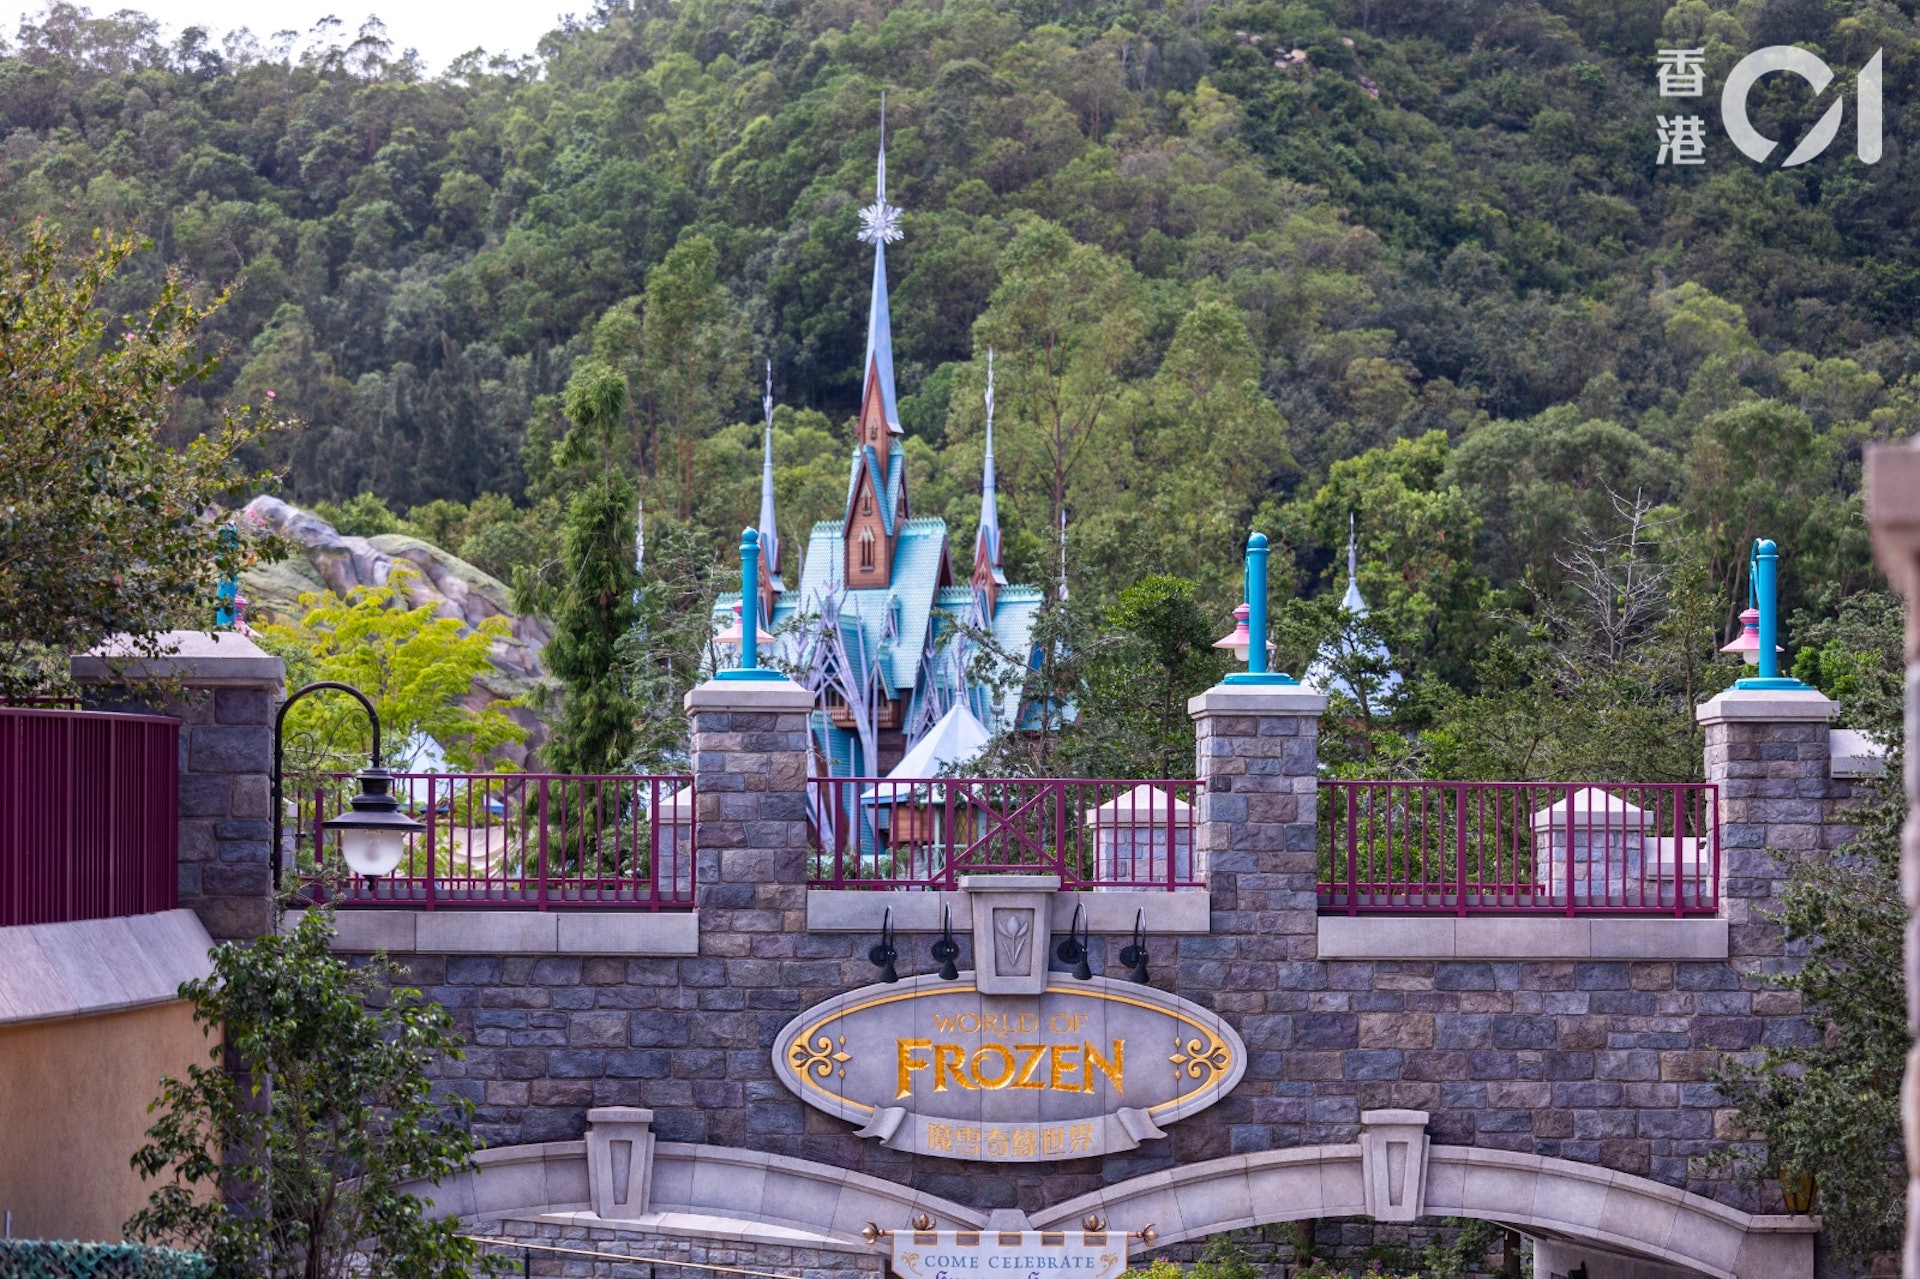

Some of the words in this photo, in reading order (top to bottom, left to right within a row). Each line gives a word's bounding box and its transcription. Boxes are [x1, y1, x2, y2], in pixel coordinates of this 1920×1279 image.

[932, 1012, 1039, 1037] WORLD
[1050, 1012, 1088, 1034] OF
[894, 1037, 1126, 1100] FROZEN
[926, 1121, 1094, 1157] 魔雪奇緣世界
[924, 1255, 979, 1269] COME
[988, 1254, 1095, 1269] CELEBRATE
